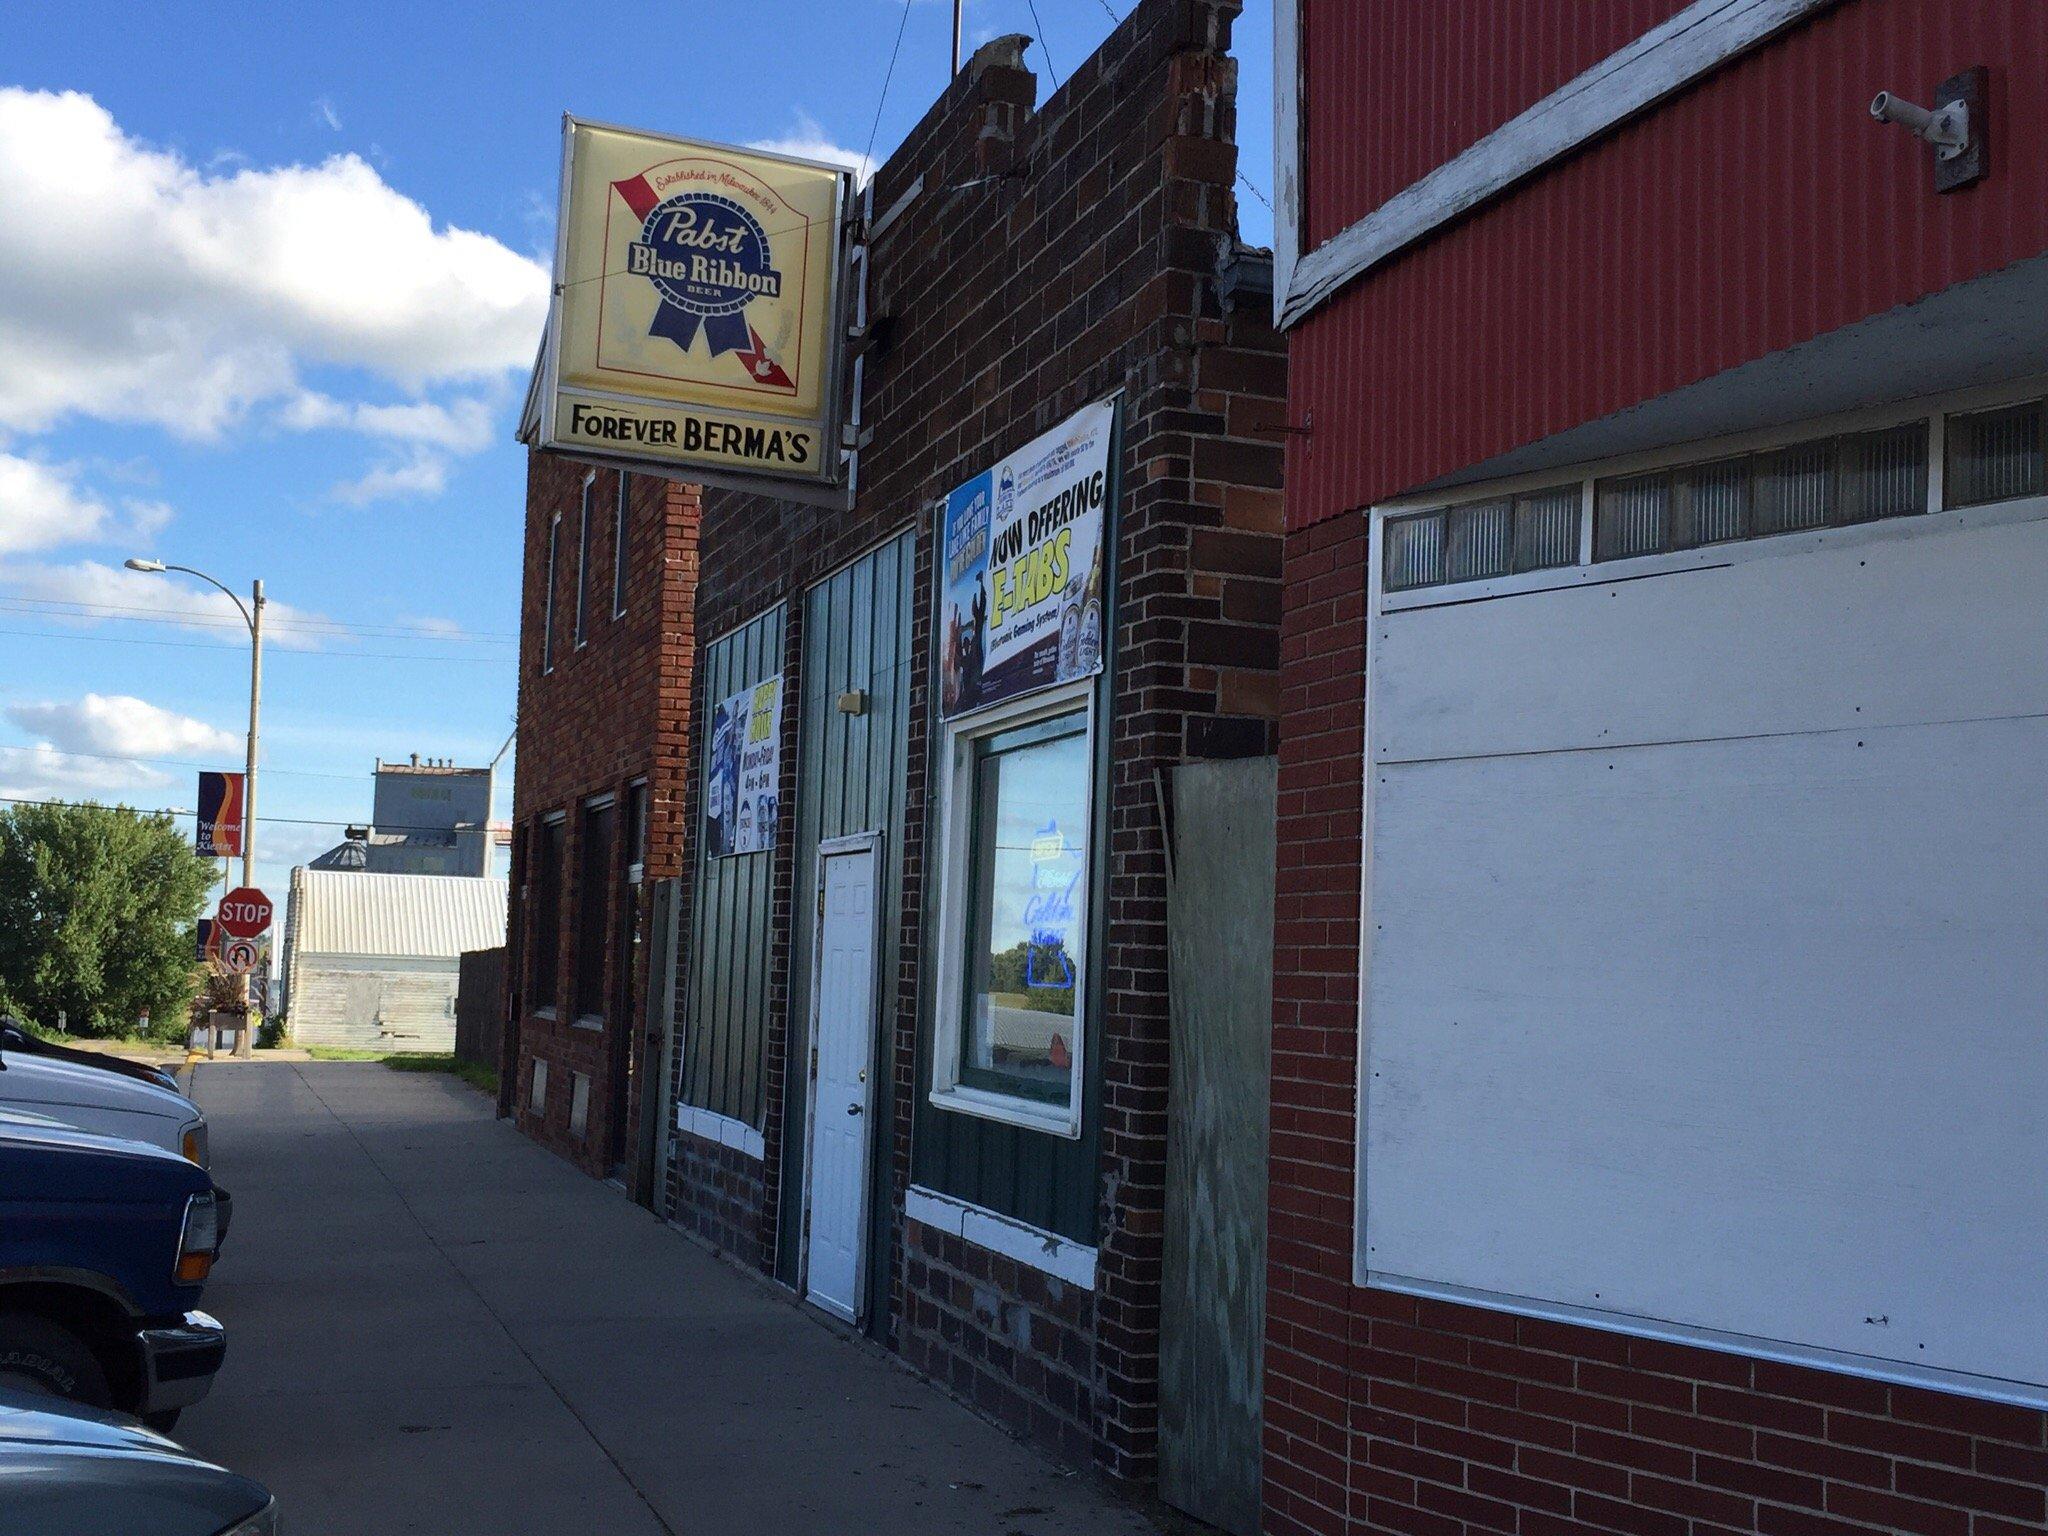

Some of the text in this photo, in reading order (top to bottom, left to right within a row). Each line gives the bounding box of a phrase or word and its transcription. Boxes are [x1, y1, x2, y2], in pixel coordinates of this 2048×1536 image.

[656, 170, 705, 191] Established
[707, 173, 718, 184] in
[660, 206, 748, 254] Pabst
[631, 244, 778, 294] Blue Ribbon
[687, 285, 722, 297] BEER
[571, 404, 811, 463] FOREVER BERMA'S
[989, 518, 1023, 571] NOW
[1028, 470, 1103, 547] OFFERING
[990, 527, 1072, 631] E-TABS
[198, 820, 242, 832] Welcome
[201, 832, 211, 841] to
[221, 902, 270, 923] STOP
